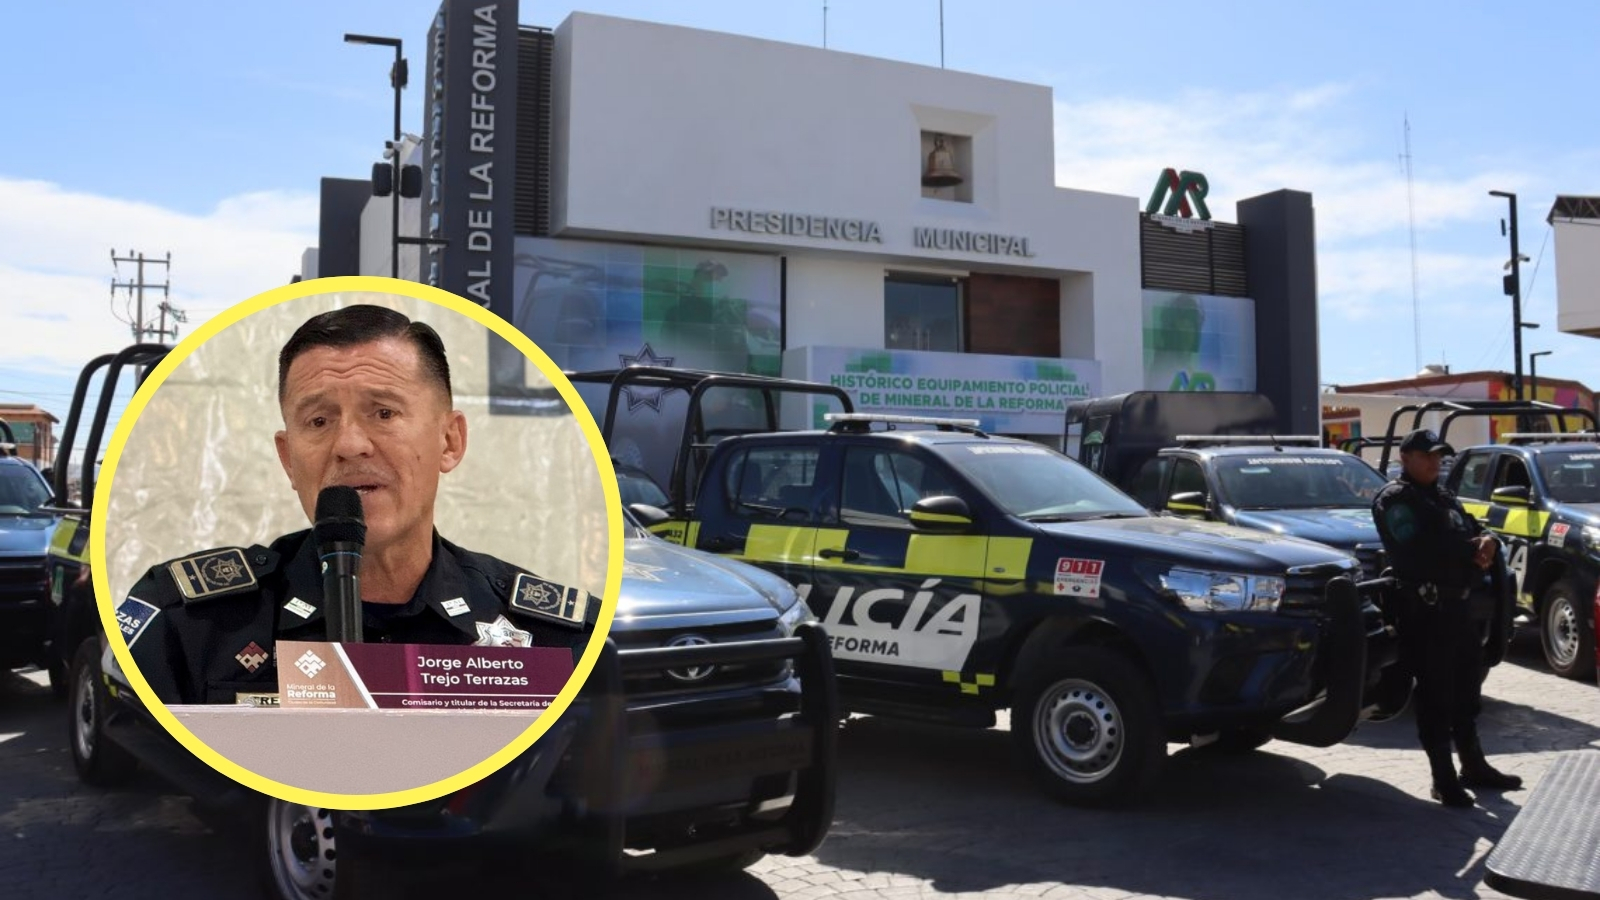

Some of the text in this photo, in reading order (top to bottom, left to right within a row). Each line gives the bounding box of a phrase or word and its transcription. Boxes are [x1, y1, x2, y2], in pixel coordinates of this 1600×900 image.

[470, 4, 497, 153] REFORMA
[469, 162, 493, 200] LA
[468, 210, 492, 251] DE
[710, 207, 1036, 257] PRESIDENCIA MUNICIPAL
[830, 370, 1088, 396] HISTÓRICO EQUIPAMIENTO POLICIAL
[860, 392, 1065, 411] DE MINERAL DE LA REFORMA
[1062, 561, 1097, 573] 911
[115, 610, 141, 629] ZAS
[119, 623, 135, 635] LES
[417, 656, 524, 670] Jorge Alberto
[421, 673, 528, 687] Trejo Terrazas
[287, 690, 336, 698] Reforma
[451, 699, 476, 707] titular
[478, 699, 488, 707] de
[490, 699, 498, 707] la
[499, 699, 540, 707] Secretaría
